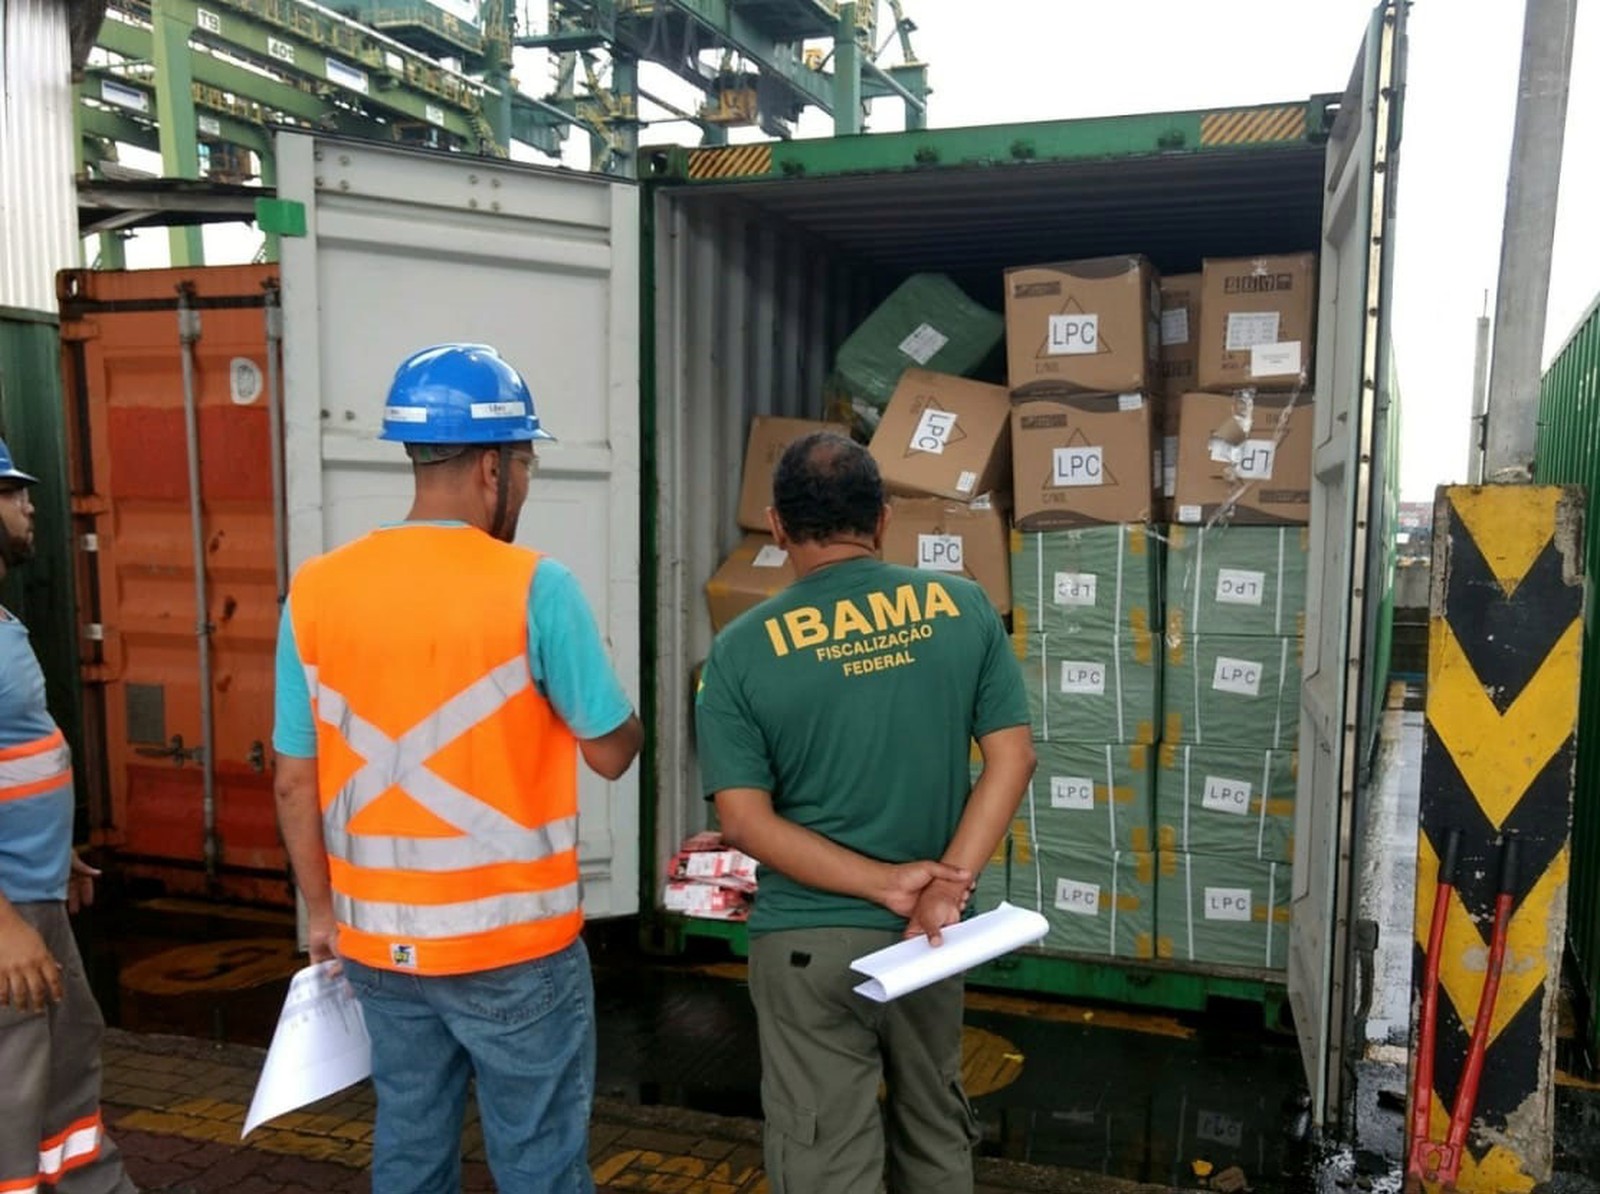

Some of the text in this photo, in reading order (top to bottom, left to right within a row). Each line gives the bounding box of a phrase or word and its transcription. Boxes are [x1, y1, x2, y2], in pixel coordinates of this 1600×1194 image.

[1052, 321, 1095, 346] LPC
[919, 414, 950, 449] LPC
[1057, 454, 1101, 477] LPC
[1239, 449, 1269, 472] LP
[921, 542, 960, 564] LPC
[1221, 580, 1257, 596] LPC
[765, 582, 961, 656] IBAMA
[816, 622, 933, 661] FISCALIZAÇÃO
[843, 650, 915, 676] FEDERAL
[1067, 667, 1101, 685] LPC
[1220, 666, 1256, 685] LPC
[1057, 784, 1090, 800] LPC
[1210, 785, 1245, 804] LPC
[1062, 887, 1094, 905] LPC
[1211, 899, 1246, 911] LPC
